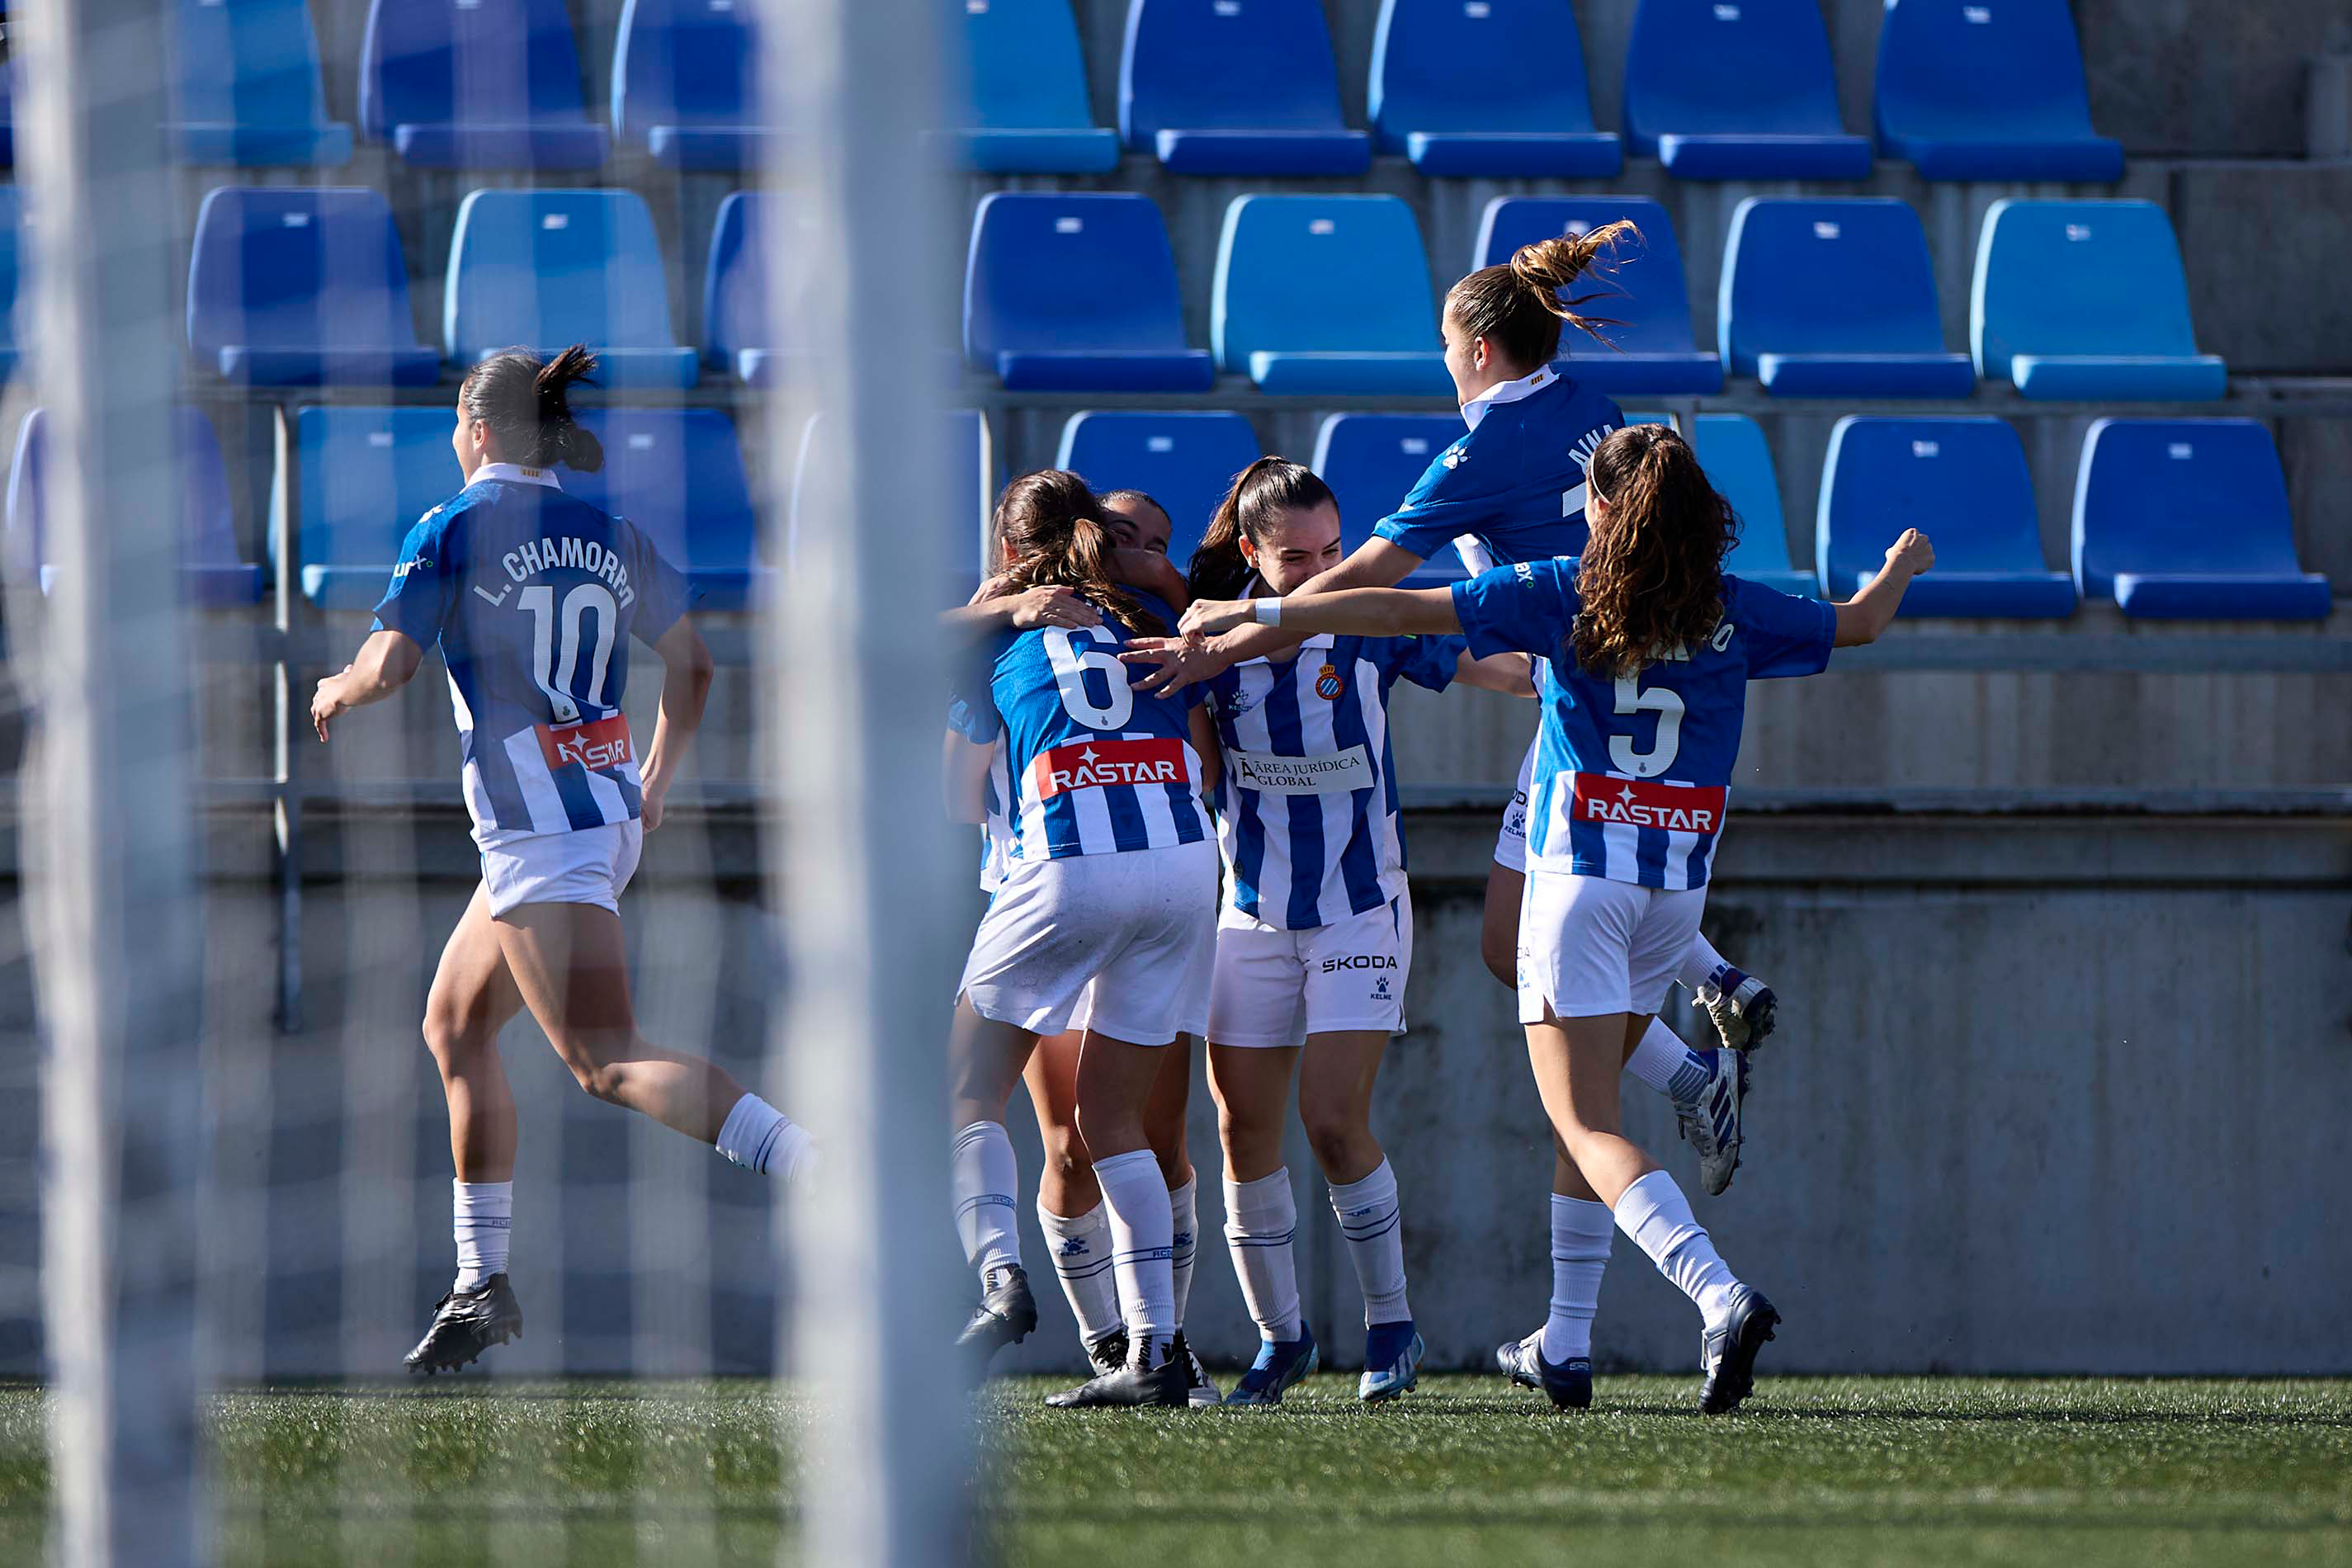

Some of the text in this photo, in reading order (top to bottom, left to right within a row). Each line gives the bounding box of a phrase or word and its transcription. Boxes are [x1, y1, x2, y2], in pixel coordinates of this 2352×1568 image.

[517, 583, 616, 722] 10
[1043, 625, 1133, 730] 6
[1609, 665, 1685, 777] 5
[1050, 760, 1178, 792] RASTAR
[1258, 775, 1316, 786] GLOBAL
[1293, 757, 1360, 776] JURÍDICA
[1588, 798, 1712, 830] RASTAR
[1322, 956, 1397, 973] SKODA
